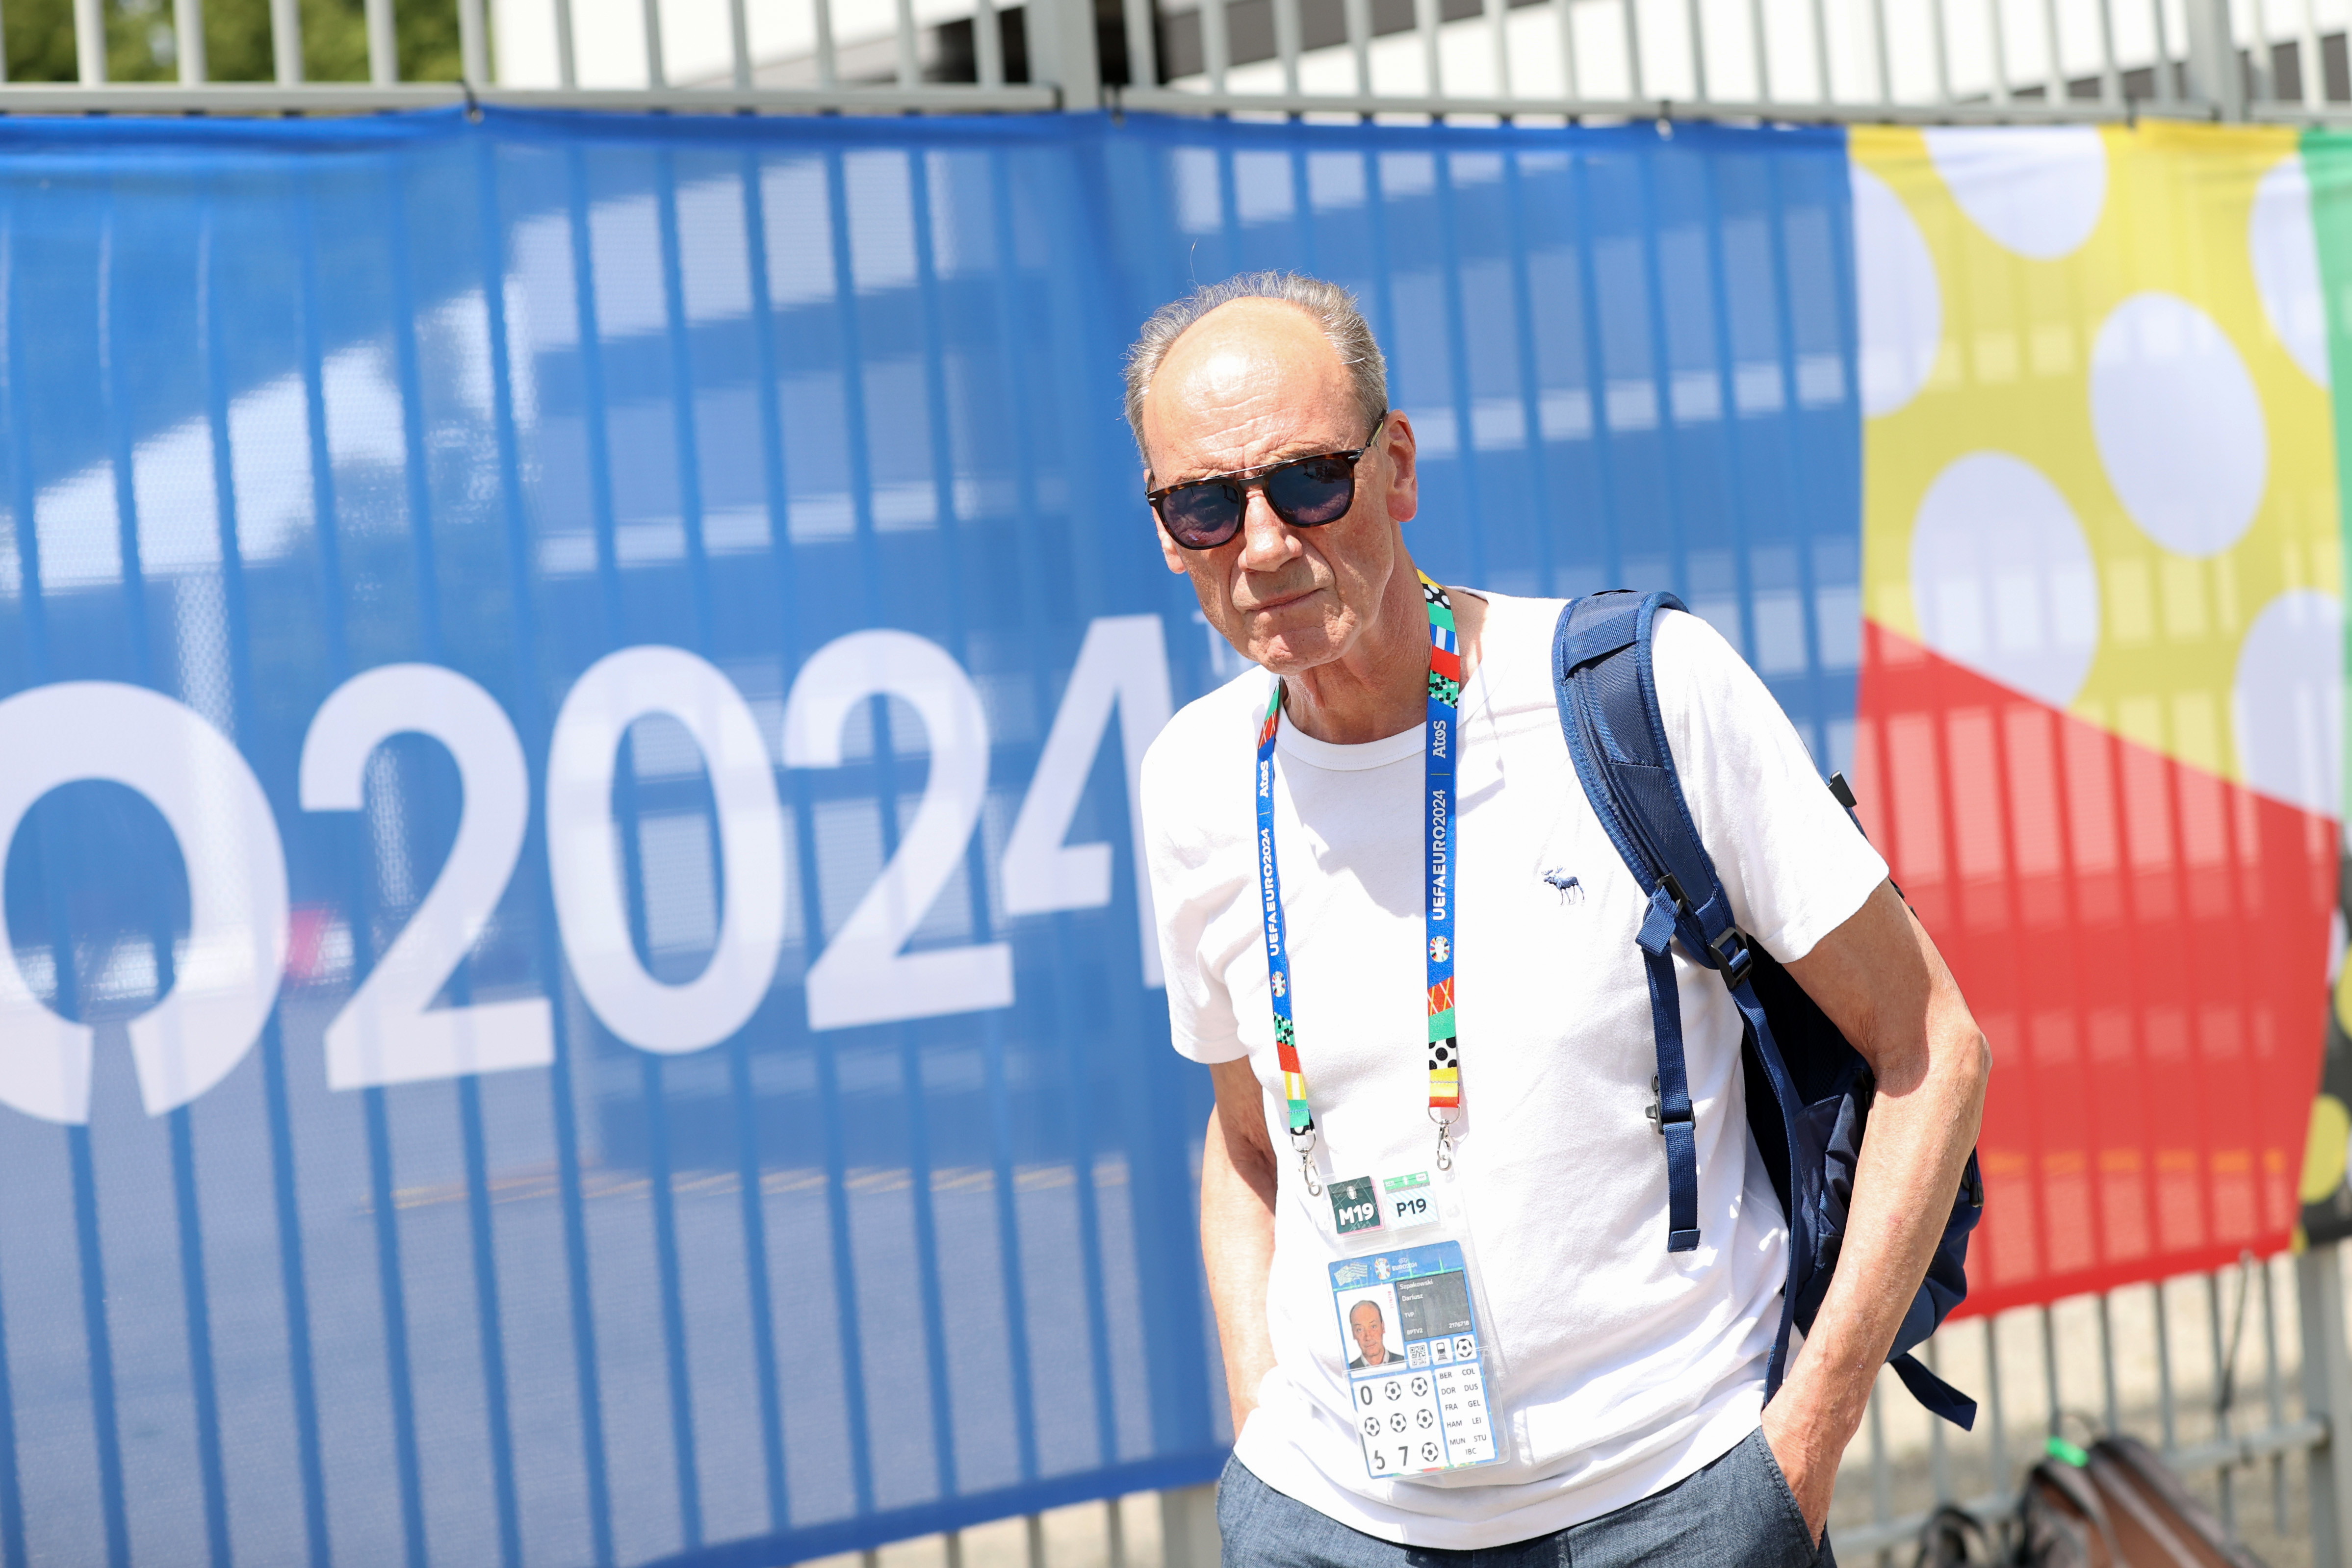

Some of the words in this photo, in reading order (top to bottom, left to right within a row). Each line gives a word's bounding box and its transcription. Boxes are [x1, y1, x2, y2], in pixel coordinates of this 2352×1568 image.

[1339, 1203, 1374, 1226] M19
[1396, 1198, 1426, 1217] P19
[1392, 1262, 1418, 1271] EURO2024
[1399, 1279, 1433, 1290] Szpakowski
[1360, 1386, 1372, 1405] 0
[1398, 1446, 1408, 1466] 7
